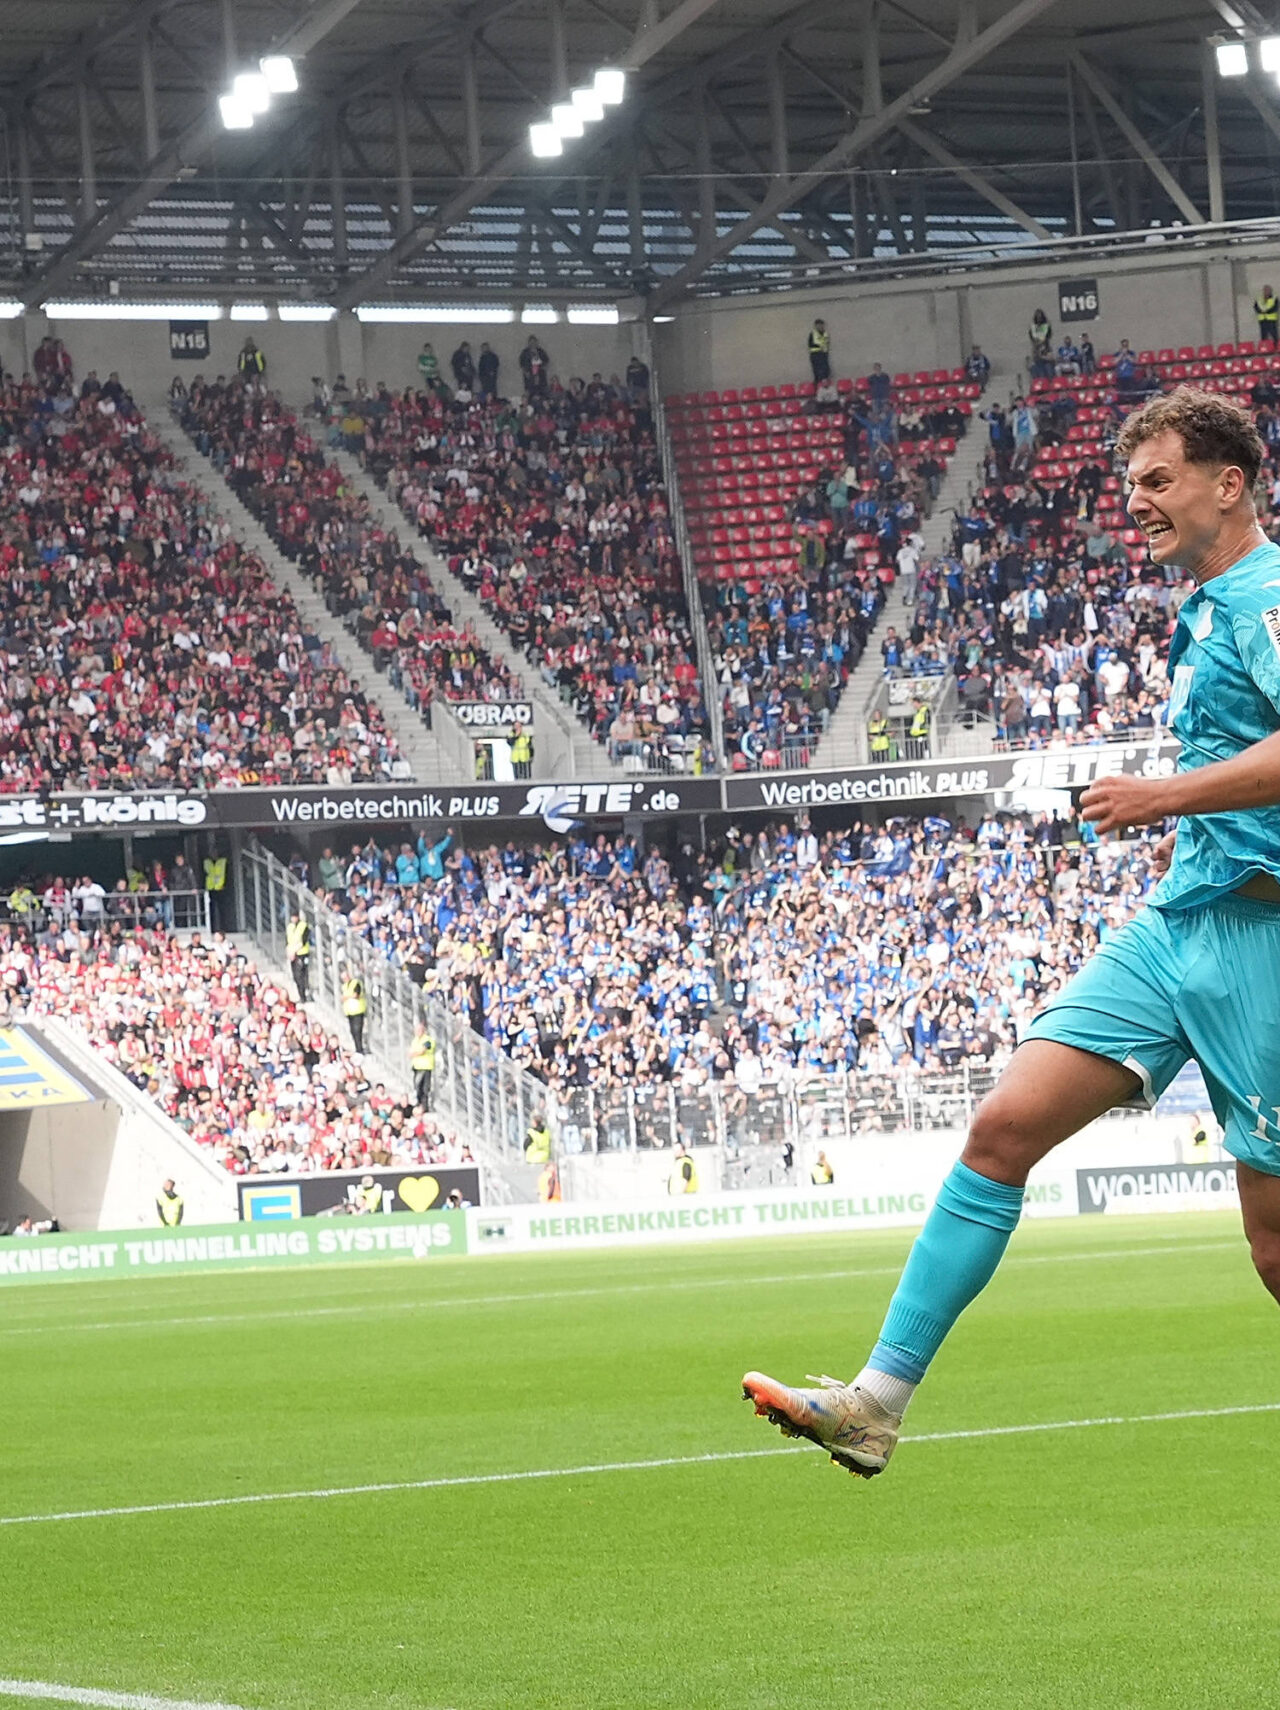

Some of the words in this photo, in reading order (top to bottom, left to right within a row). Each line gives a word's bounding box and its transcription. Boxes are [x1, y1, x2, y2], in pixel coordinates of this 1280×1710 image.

[1061, 295, 1097, 312] N16
[171, 333, 206, 349] N15
[760, 771, 932, 806] Werbetechnik
[936, 769, 989, 793] PLUS
[82, 795, 207, 825] könig
[272, 794, 444, 821] Werbetechnik
[448, 796, 500, 817] PLUS
[529, 1205, 743, 1239] HERRENKNECHT
[748, 1192, 926, 1231] TUNNELLING
[124, 1229, 309, 1265] TUNNELLING
[318, 1223, 452, 1255] SYSTEMS
